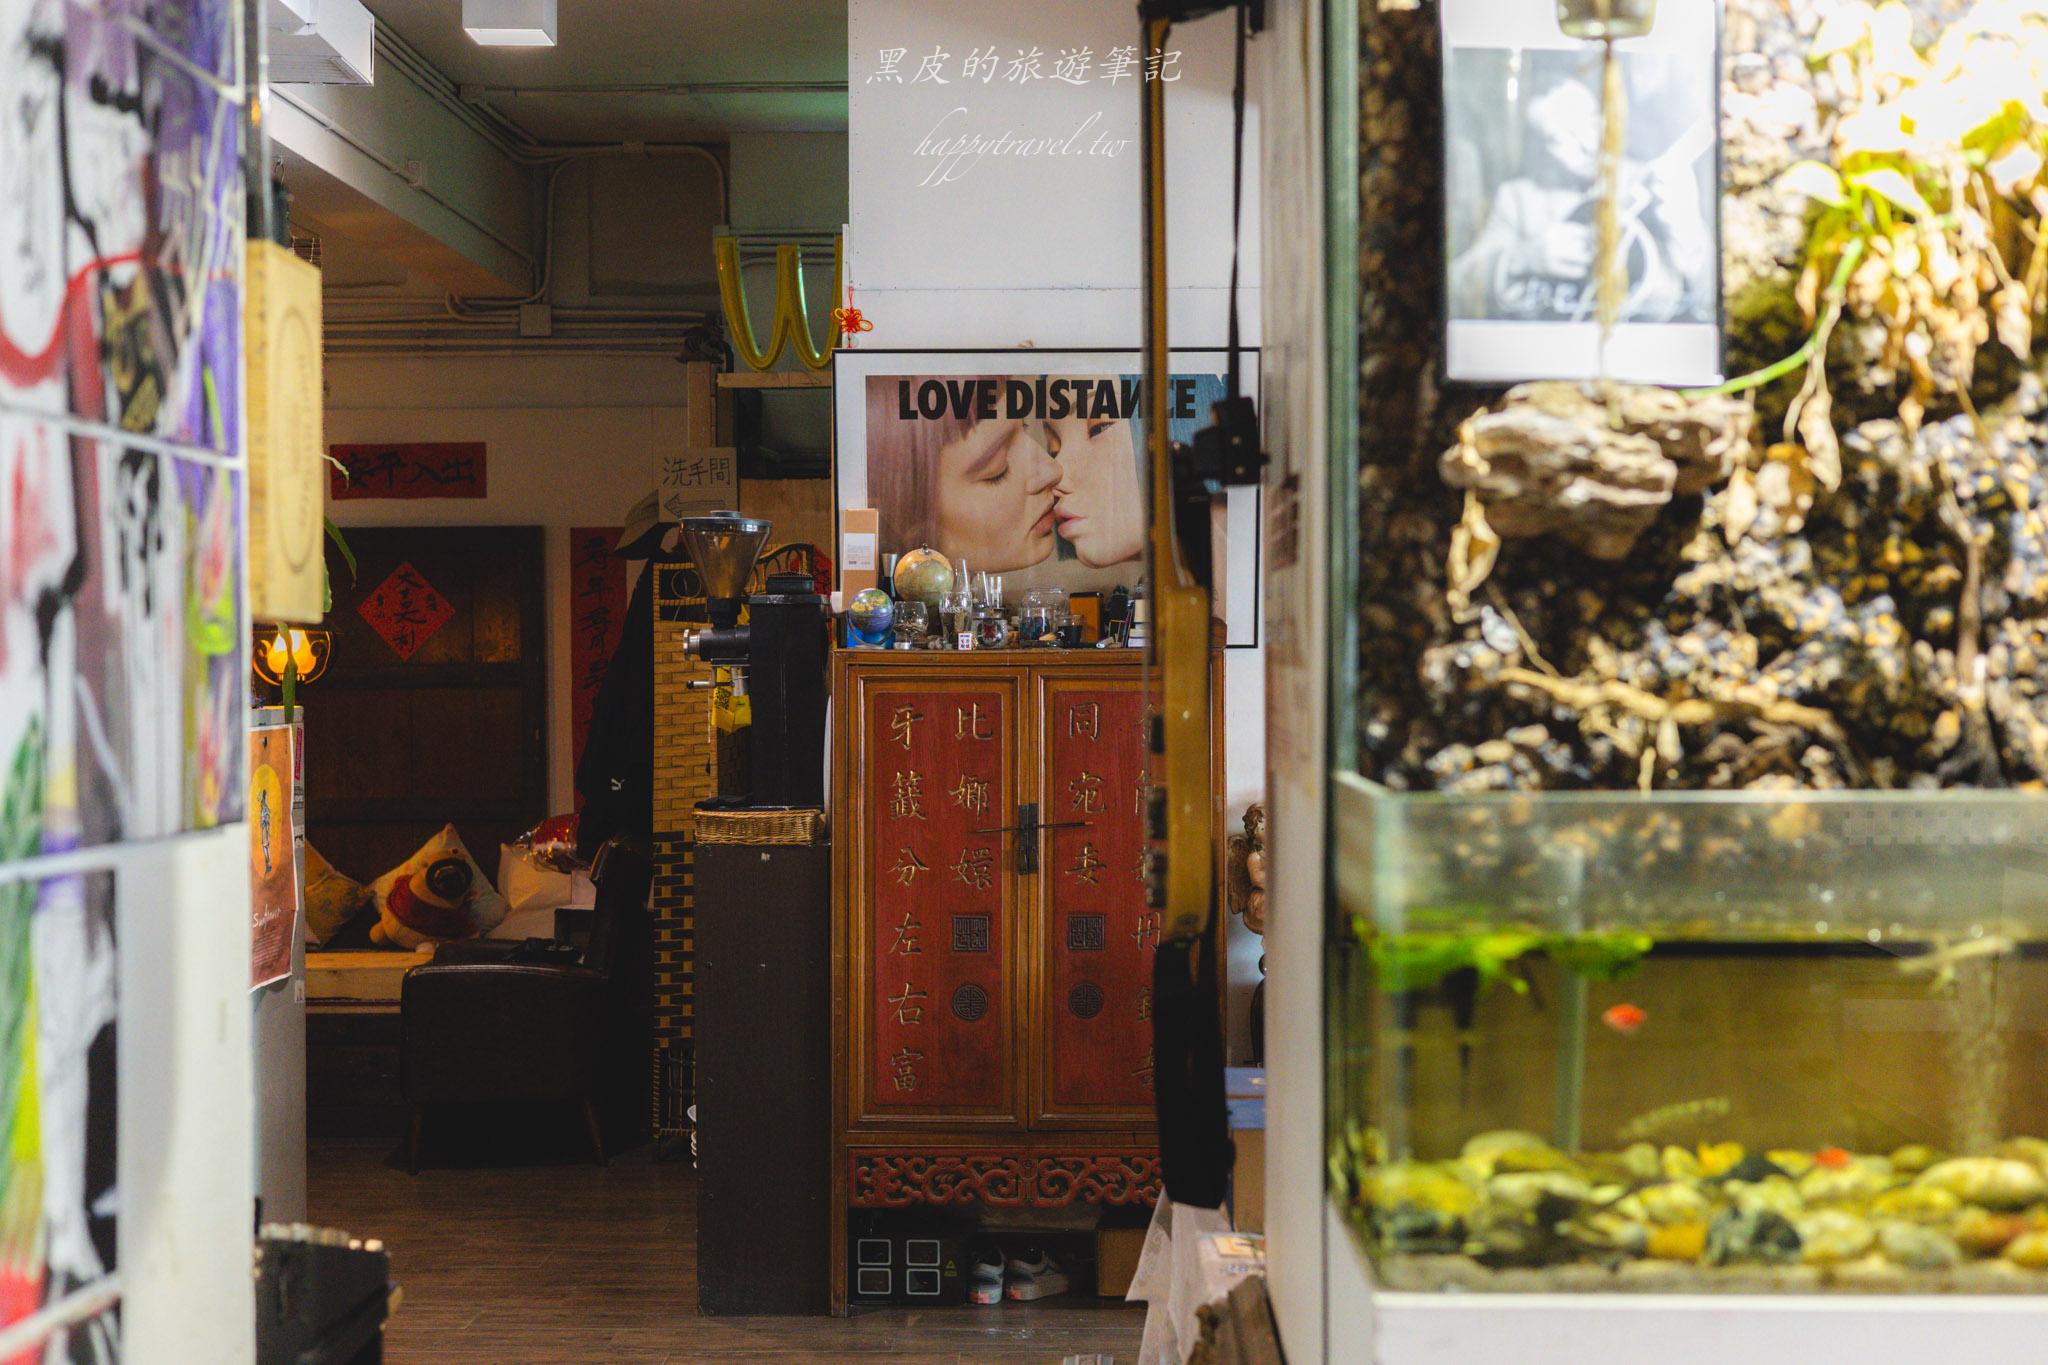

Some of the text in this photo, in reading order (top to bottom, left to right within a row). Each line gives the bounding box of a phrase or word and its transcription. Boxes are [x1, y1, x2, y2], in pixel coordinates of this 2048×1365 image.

[899, 379, 997, 420] LOVE
[662, 456, 730, 487] 洗手間
